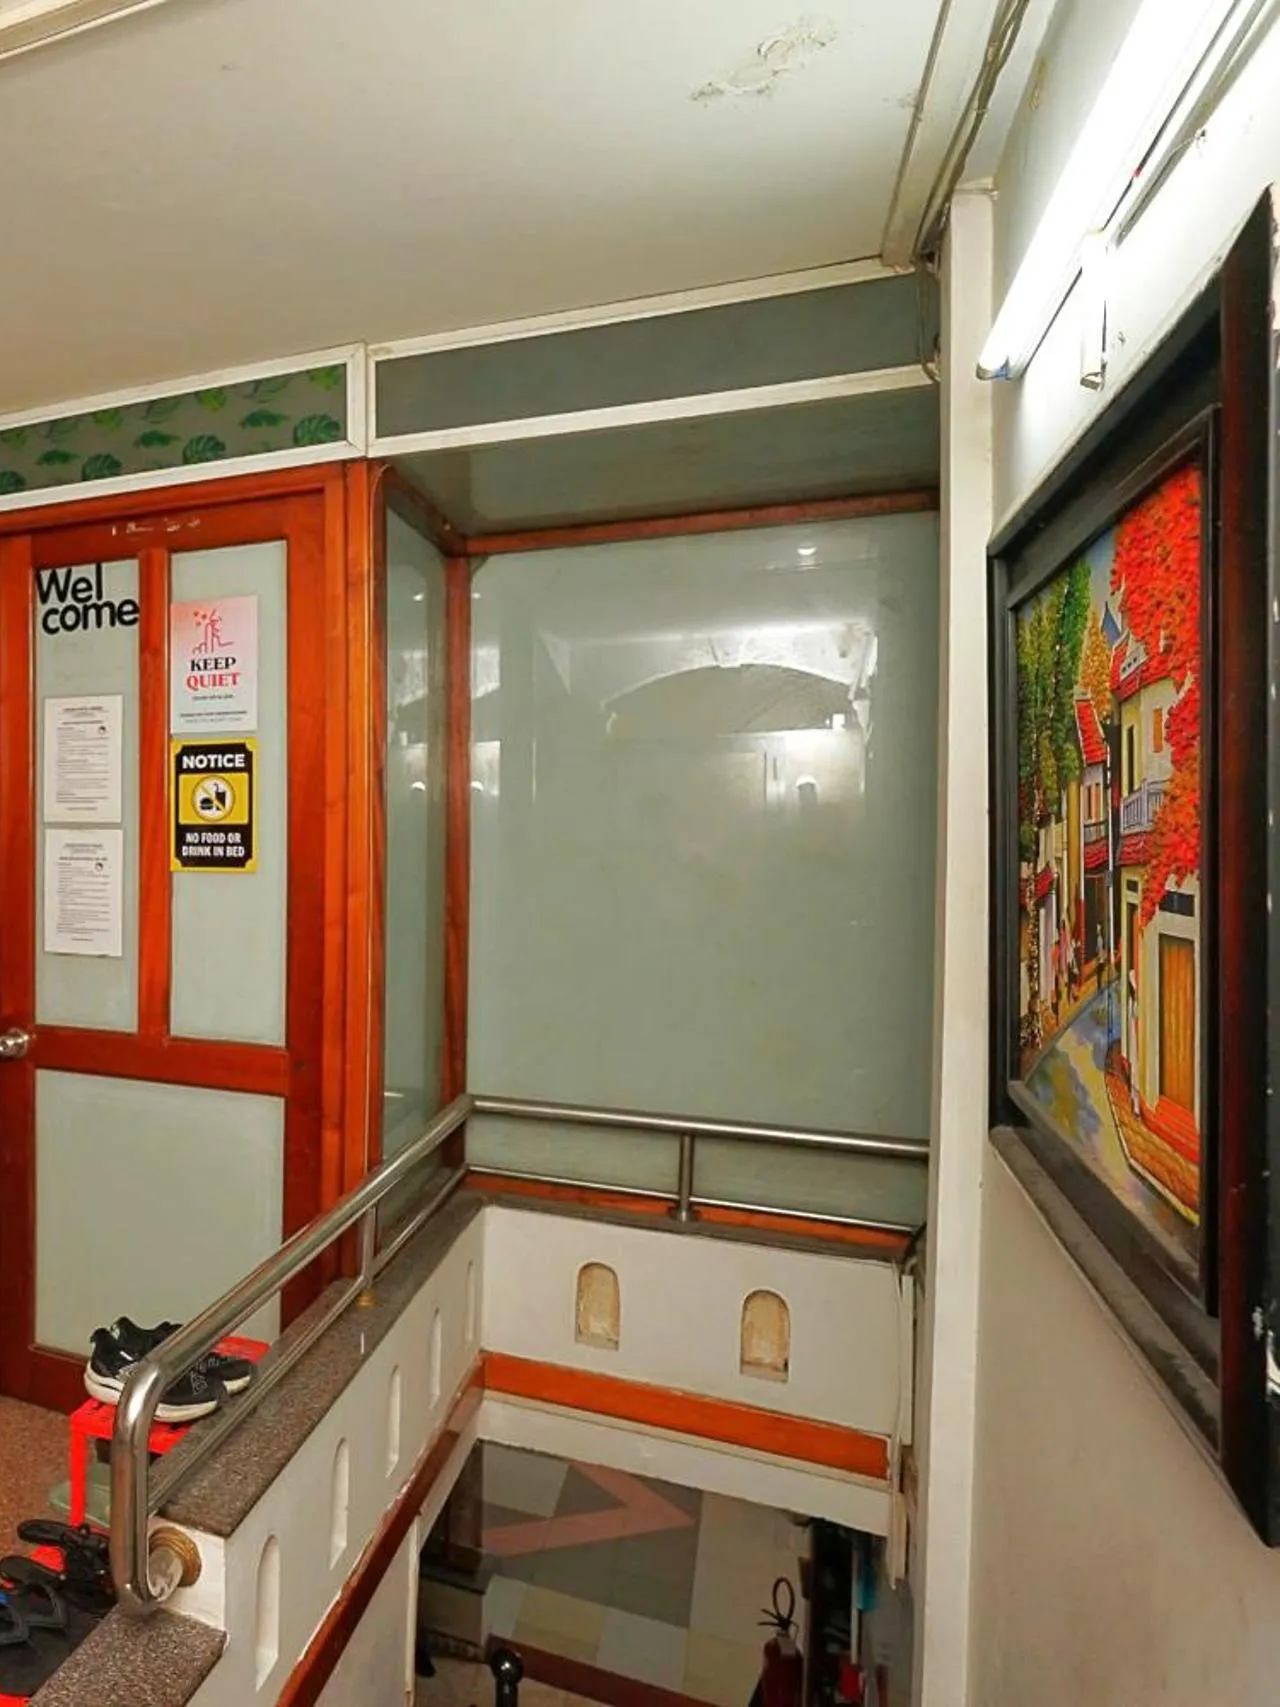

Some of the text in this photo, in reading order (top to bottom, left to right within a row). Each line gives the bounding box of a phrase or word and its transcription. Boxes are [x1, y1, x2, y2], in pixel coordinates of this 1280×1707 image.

[35, 562, 103, 605] Wel
[42, 598, 140, 635] come
[190, 656, 237, 672] KEEP
[186, 671, 241, 691] QUIET
[182, 753, 245, 769] NOTICE
[185, 832, 242, 843] NO FOOD OR
[182, 845, 245, 857] DRINK IN BED
